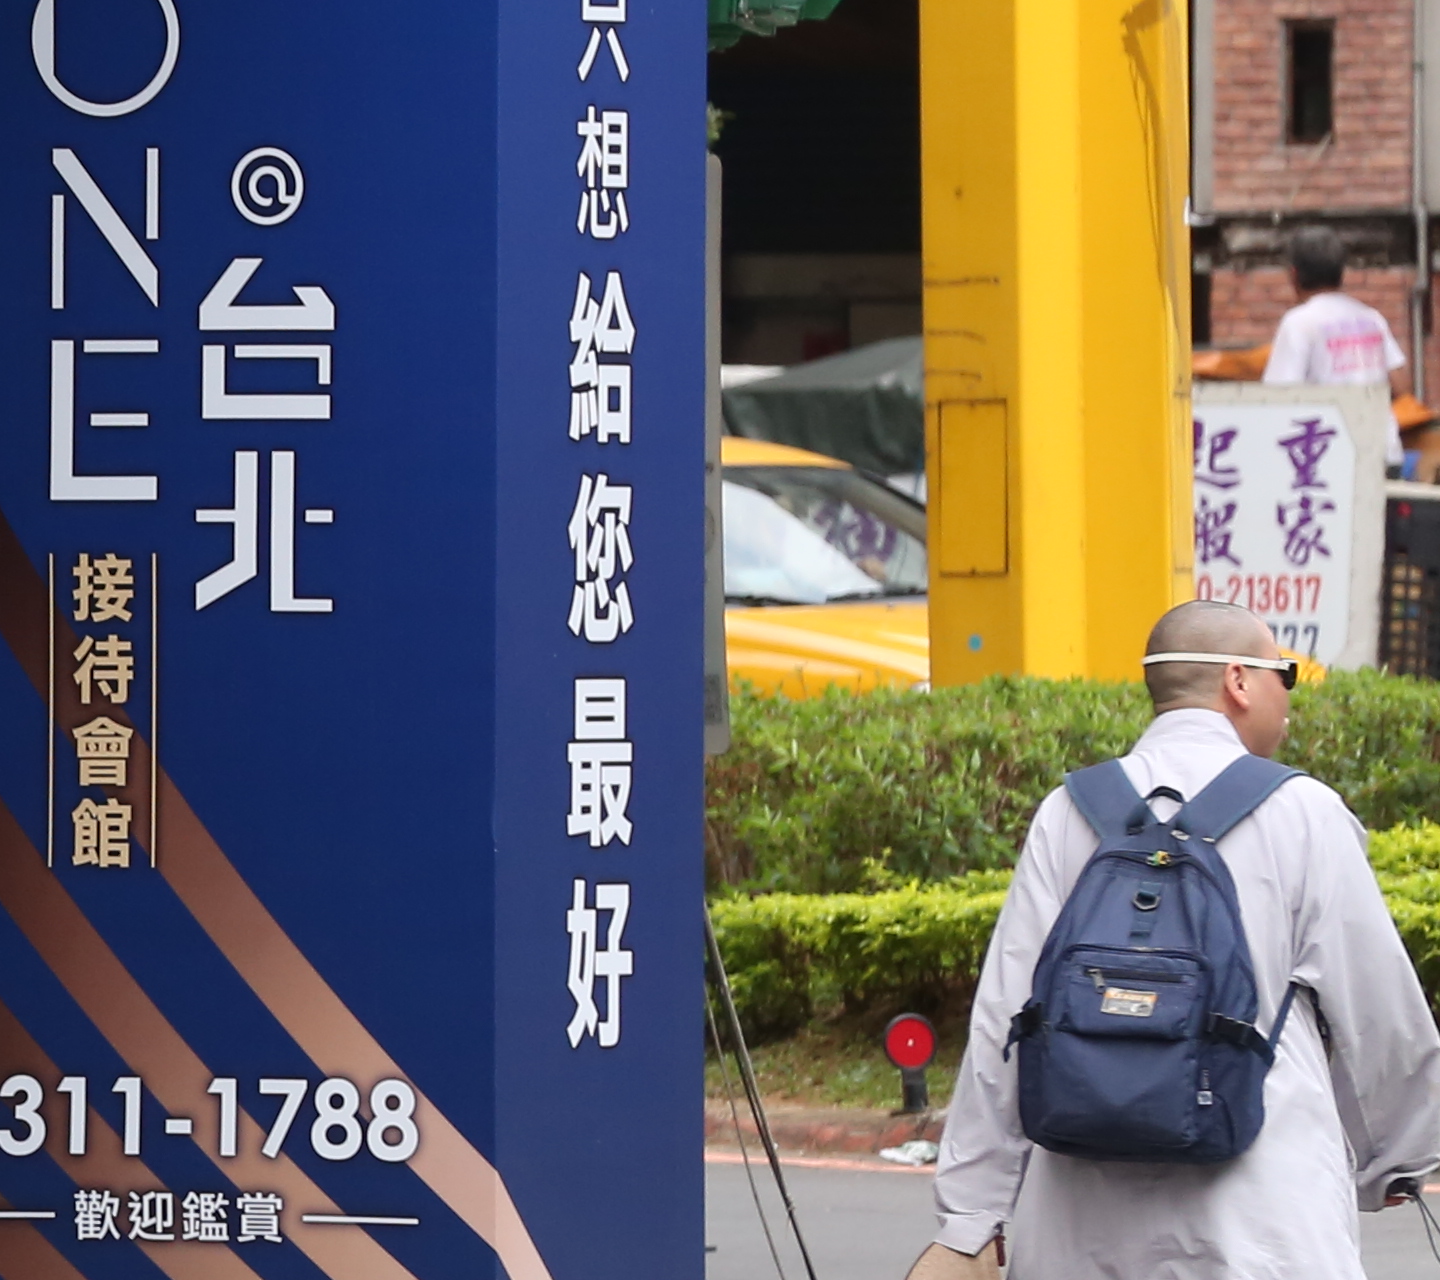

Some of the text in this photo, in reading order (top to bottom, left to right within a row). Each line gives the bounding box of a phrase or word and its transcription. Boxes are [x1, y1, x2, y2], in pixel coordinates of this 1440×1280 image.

[71, 552, 136, 870] 接待會館
[73, 1189, 284, 1244] 歡迎鑑賞
